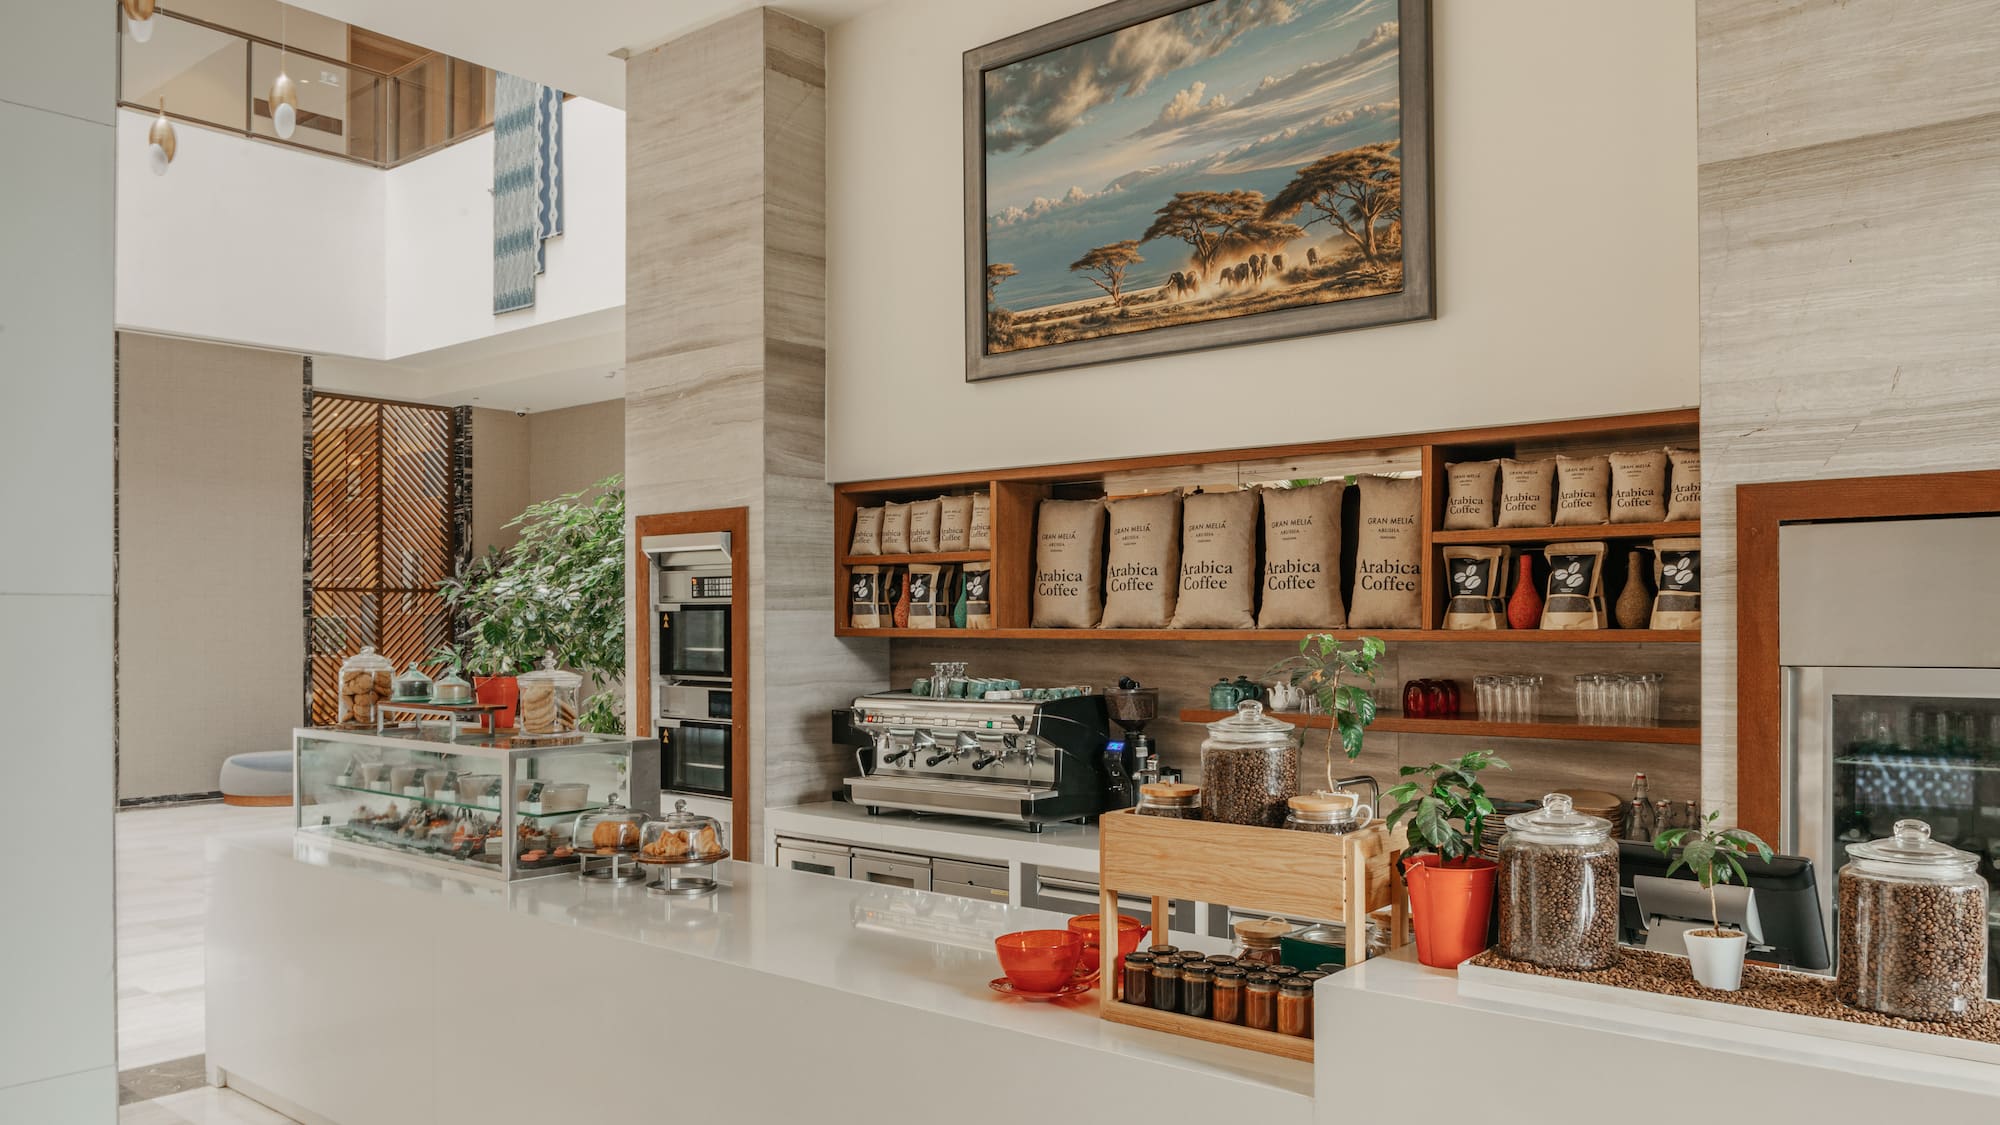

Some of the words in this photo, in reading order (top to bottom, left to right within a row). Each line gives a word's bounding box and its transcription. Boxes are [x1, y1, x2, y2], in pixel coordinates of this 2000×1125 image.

[1616, 488, 1655, 498] Arabica
[1673, 482, 1701, 493] Arabi
[1504, 492, 1540, 502] Arabica
[1560, 489, 1596, 500] Arabica
[1675, 492, 1701, 503] Coff
[1449, 496, 1484, 506] Arabica
[1561, 498, 1593, 509] Coffee
[1617, 497, 1652, 508] Coffee
[1450, 505, 1481, 515] Coffee
[1505, 502, 1537, 512] Coffee
[1271, 520, 1289, 529] GRAN
[1367, 517, 1388, 525] GRAN
[1114, 526, 1130, 535] GRAN
[1188, 524, 1204, 532] GRAN
[1041, 533, 1057, 541] GRAN
[1109, 562, 1158, 578] Arabica
[1182, 560, 1233, 576] Arabica
[1266, 559, 1321, 575] Arabica
[1360, 559, 1421, 575] Arabica
[1037, 569, 1083, 582] Arabica
[1111, 577, 1154, 592] Coffee
[1184, 575, 1228, 591] Coffee
[1268, 574, 1316, 591] Coffee
[1361, 575, 1416, 592] Coffee
[1038, 582, 1079, 596] Coffee
